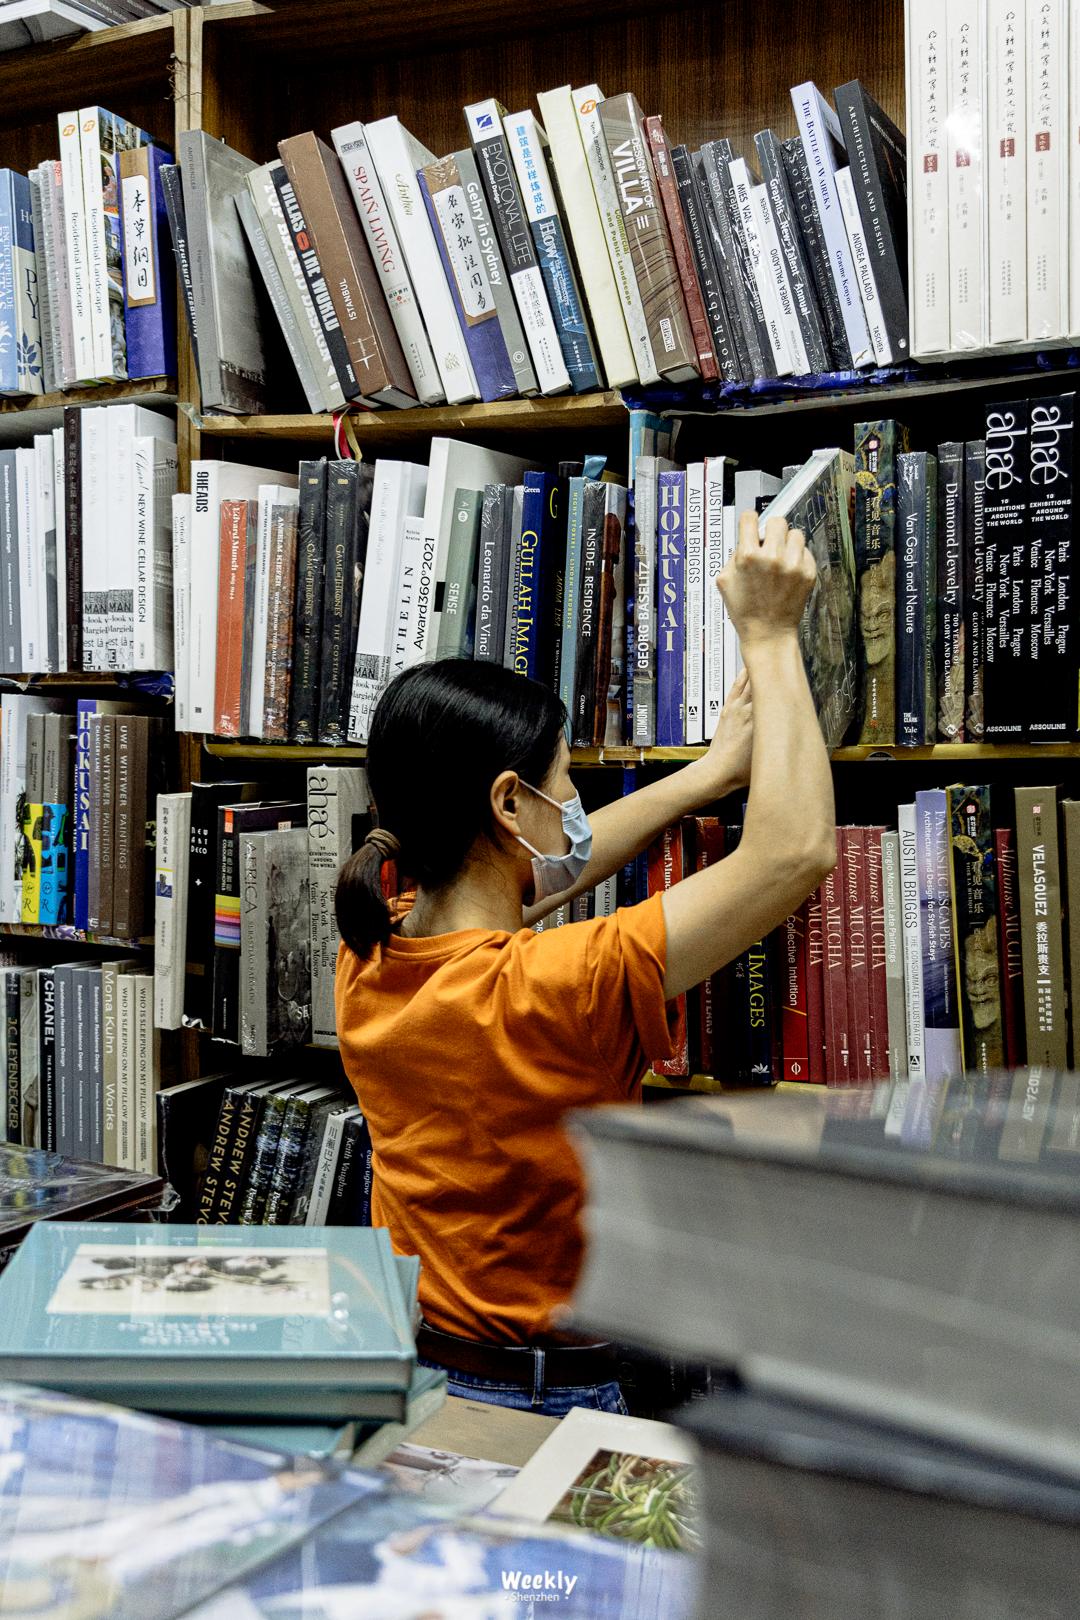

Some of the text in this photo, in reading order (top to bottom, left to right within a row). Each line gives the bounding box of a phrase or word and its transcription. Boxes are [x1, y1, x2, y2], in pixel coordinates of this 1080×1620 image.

[612, 140, 642, 215] VILLA
[631, 137, 654, 208] DESIGN ART OF
[801, 99, 832, 210] THE BATTLE OF WAIREKA
[847, 105, 887, 257] ARCHITECTURE AND DESIGN
[132, 189, 150, 288] 本草纲目
[279, 182, 306, 233] VILLAS
[466, 182, 503, 286] Gehry in Sydney
[485, 142, 532, 265] EMOTIONAL LIFE
[539, 220, 560, 259] How
[736, 184, 754, 223] MIES VAN
[760, 198, 771, 224] TASCHEN
[71, 211, 85, 317] Residential Landscape
[90, 208, 104, 314] Residential Landscape
[447, 194, 487, 310] 名家批注周易
[769, 178, 810, 316] Graphis New Talent Annual
[770, 249, 792, 315] ANDREA PALLADIO
[835, 250, 854, 306] Graeme Kenyon
[851, 233, 874, 301] ANDREA PALLADIO
[338, 279, 358, 321] ISTANBUL
[769, 320, 782, 351] TASCHEN
[872, 326, 884, 353] TASCHEN
[984, 412, 1027, 490] ahaé
[1029, 405, 1073, 485] ahaé
[195, 471, 209, 512] 9HEADS
[231, 507, 240, 539] Edvard
[708, 481, 722, 578] AUSTIN BRIGGS
[984, 504, 1026, 512] EXHIBITIONS
[1030, 500, 1072, 508] EXHIBITIONS
[138, 548, 146, 583] CELLAR
[230, 540, 240, 571] Munch
[660, 486, 682, 652] HOKUSAI
[688, 488, 701, 584] AUSTIN BRIGGS
[903, 512, 918, 633] Van Gogh and Nature
[943, 483, 959, 605] Diamond Jewelry
[138, 585, 146, 623] DESIGN
[446, 582, 460, 615] SENSE
[478, 542, 495, 655] Leonardo da Vinci
[582, 528, 597, 637] INSIDE: RESIDENCE
[637, 561, 650, 668] GEORG BASELITZ
[985, 544, 996, 662] Venice Florence Moscow
[998, 554, 1009, 648] New York Versailles
[1011, 545, 1023, 657] Paris London Prague
[1029, 539, 1041, 660] Venice Florence Moscow
[1043, 550, 1056, 645] New York Versailles
[1056, 540, 1070, 654] Paris London Prague
[636, 704, 648, 736] DUMONT
[103, 755, 111, 806] WITTWER
[119, 725, 128, 869] UWE WITTWER PAINTINGS
[308, 776, 337, 839] ahaé
[102, 812, 111, 868] PAINTINGS
[845, 840, 864, 968] Alphonse MUCHA
[868, 841, 885, 969] Alphonse MUCHA
[885, 842, 896, 963] Giorgio Morandi: Late Paintings
[902, 830, 918, 928] AUSTIN BRIGGS
[924, 810, 937, 961] Architecture and Design for Stylish Stays
[935, 810, 950, 949] FANTASTIC ESCAPES
[1032, 844, 1047, 916] VELASQUEZ
[786, 916, 798, 1006] Collective Intuition
[808, 903, 822, 966] MUCHA
[827, 905, 842, 969] MUCHA
[1036, 921, 1050, 976] 委拉斯贵支
[44, 980, 54, 1045] CHANEL
[748, 953, 766, 1028] IMAGES
[8, 1017, 18, 1129] J.C. LEYENDECKER
[105, 971, 115, 1131] Mona Kuhn Works
[122, 1059, 128, 1070] ON
[122, 1072, 128, 1085] MY
[140, 1060, 146, 1072] ON
[140, 1074, 146, 1086] MY
[335, 1137, 355, 1198] Keith Vaughan
